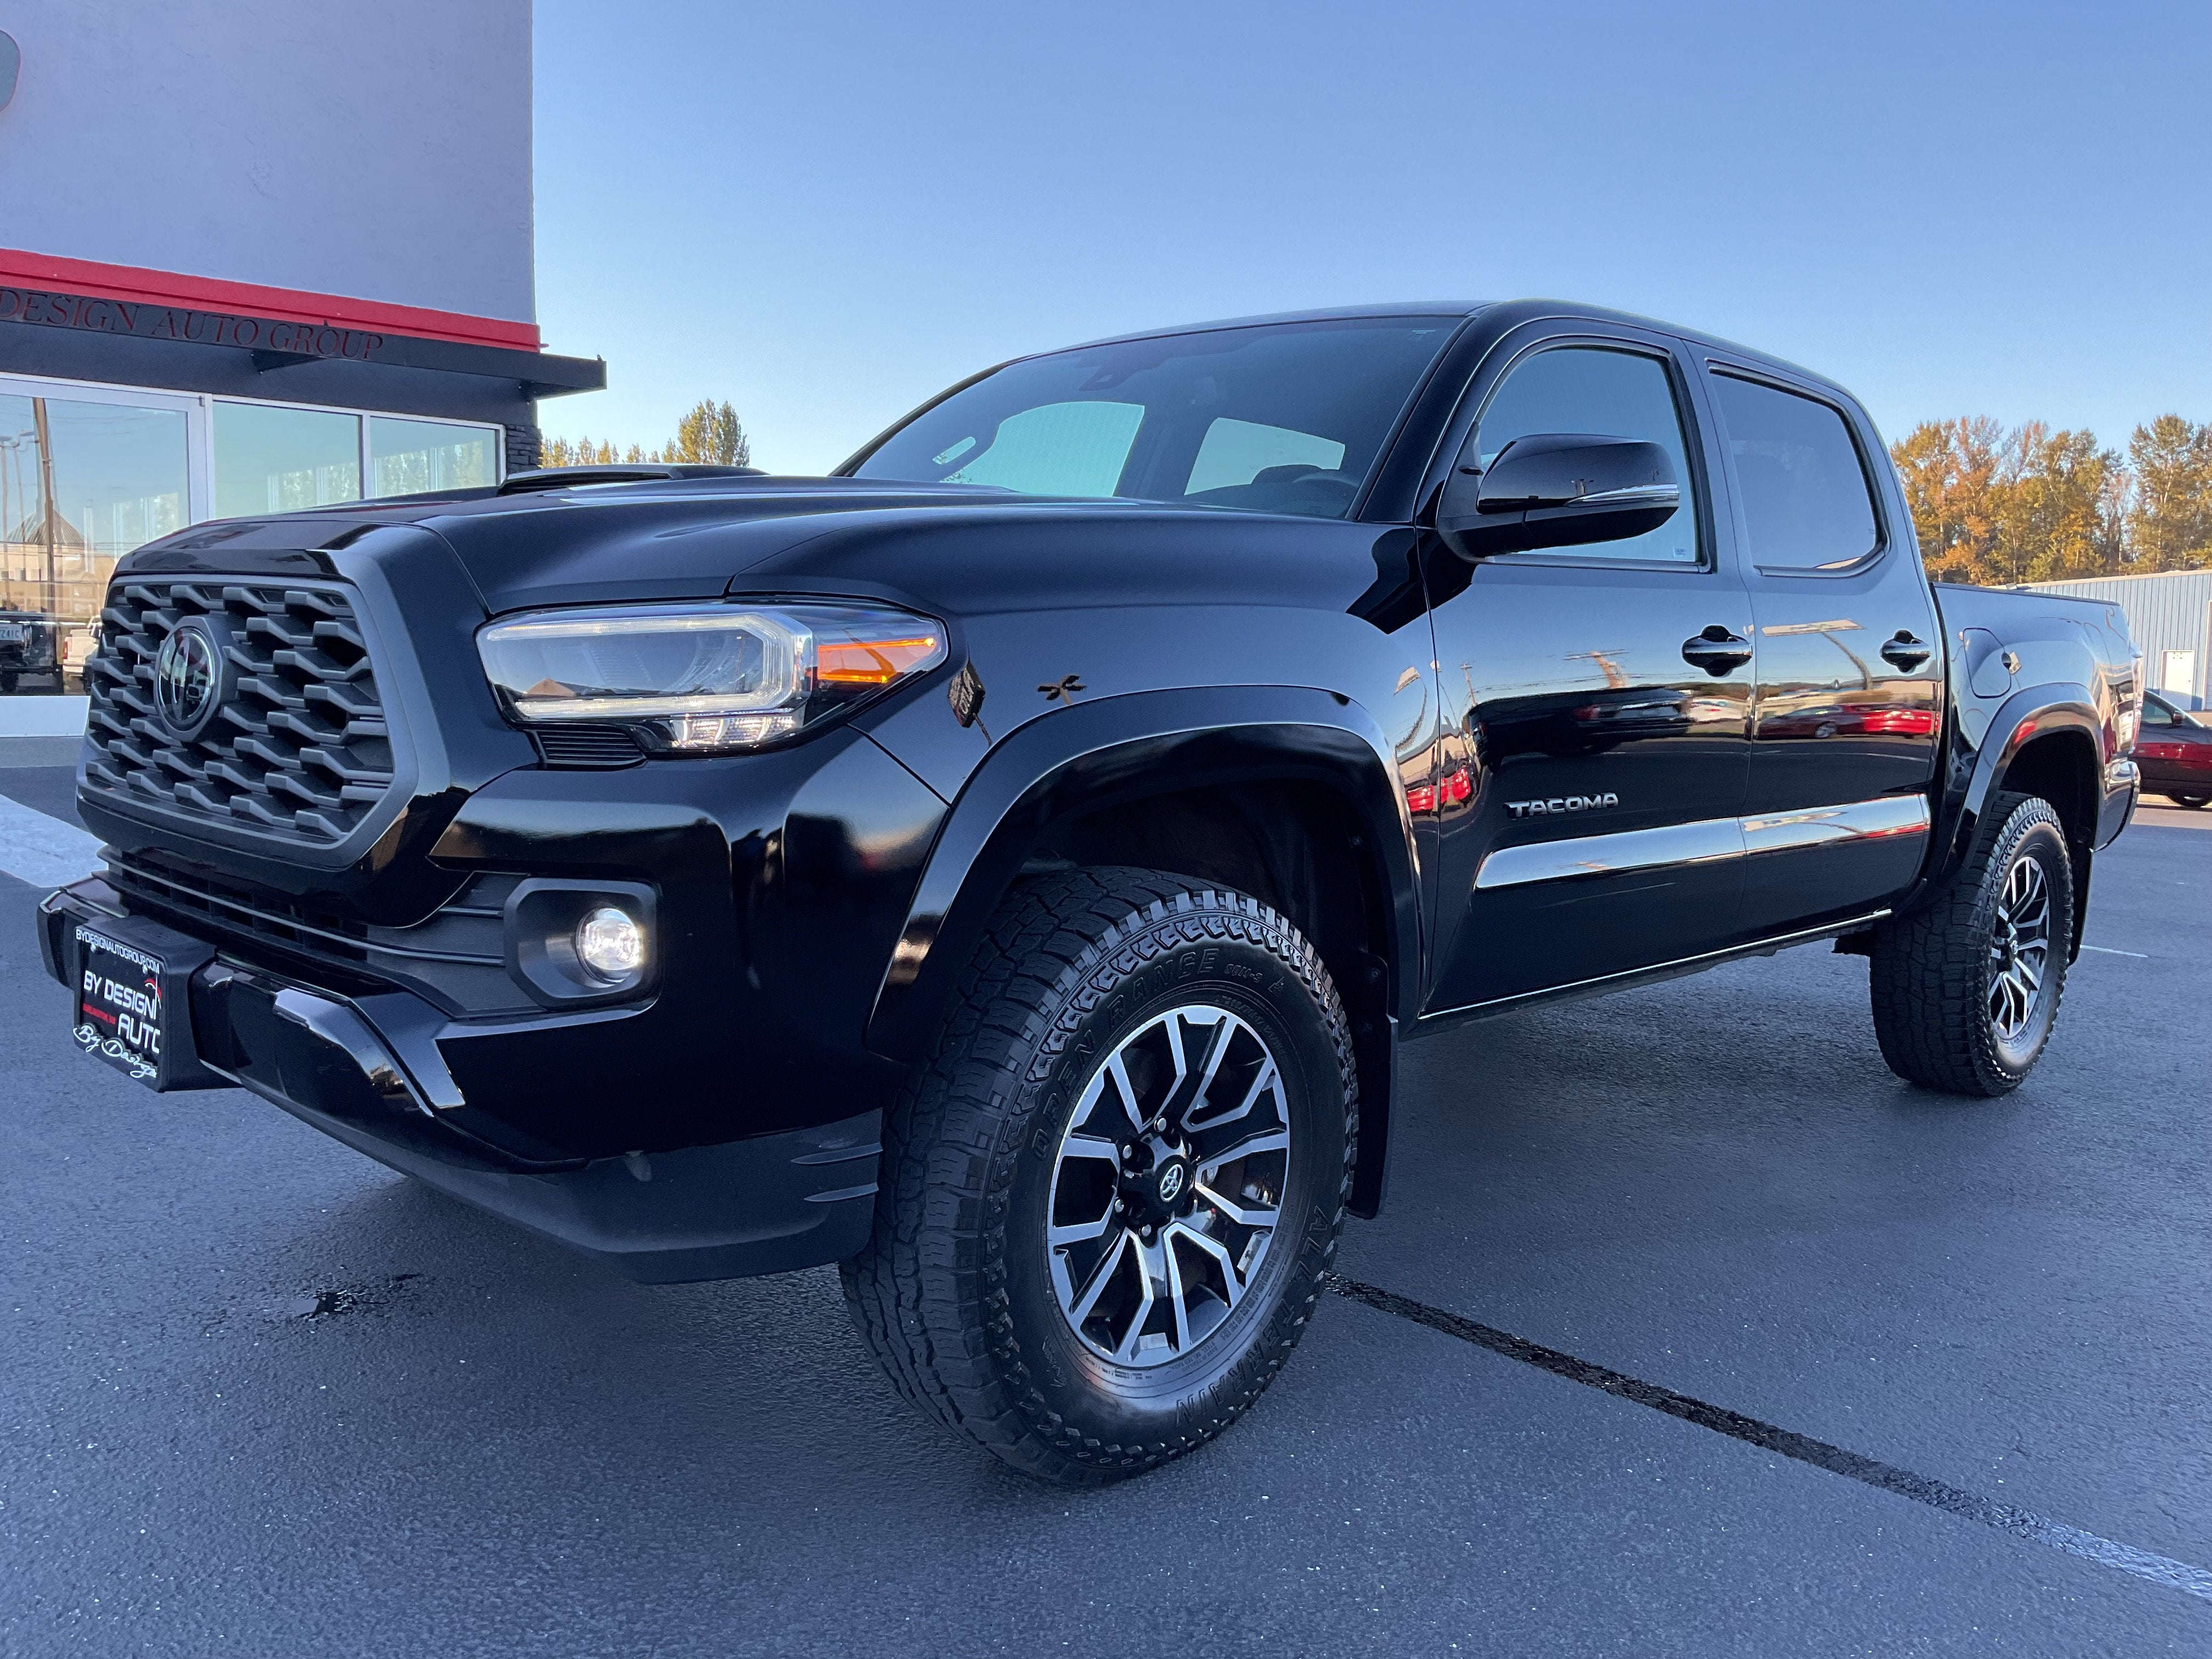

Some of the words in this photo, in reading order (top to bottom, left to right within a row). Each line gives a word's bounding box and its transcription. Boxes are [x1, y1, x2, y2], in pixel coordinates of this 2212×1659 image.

[0, 289, 139, 331] DESIGN
[151, 311, 259, 346] AUTO
[269, 323, 383, 359] GROUP
[1503, 792, 1618, 817] TACOMA
[83, 969, 102, 994] BY
[104, 978, 156, 1019] DESIGN
[72, 1024, 101, 1053] By
[1031, 1029, 1094, 1160] OPEN
[1107, 948, 1220, 1030] RANGE
[1176, 1298, 1295, 1426] TERRAIN
